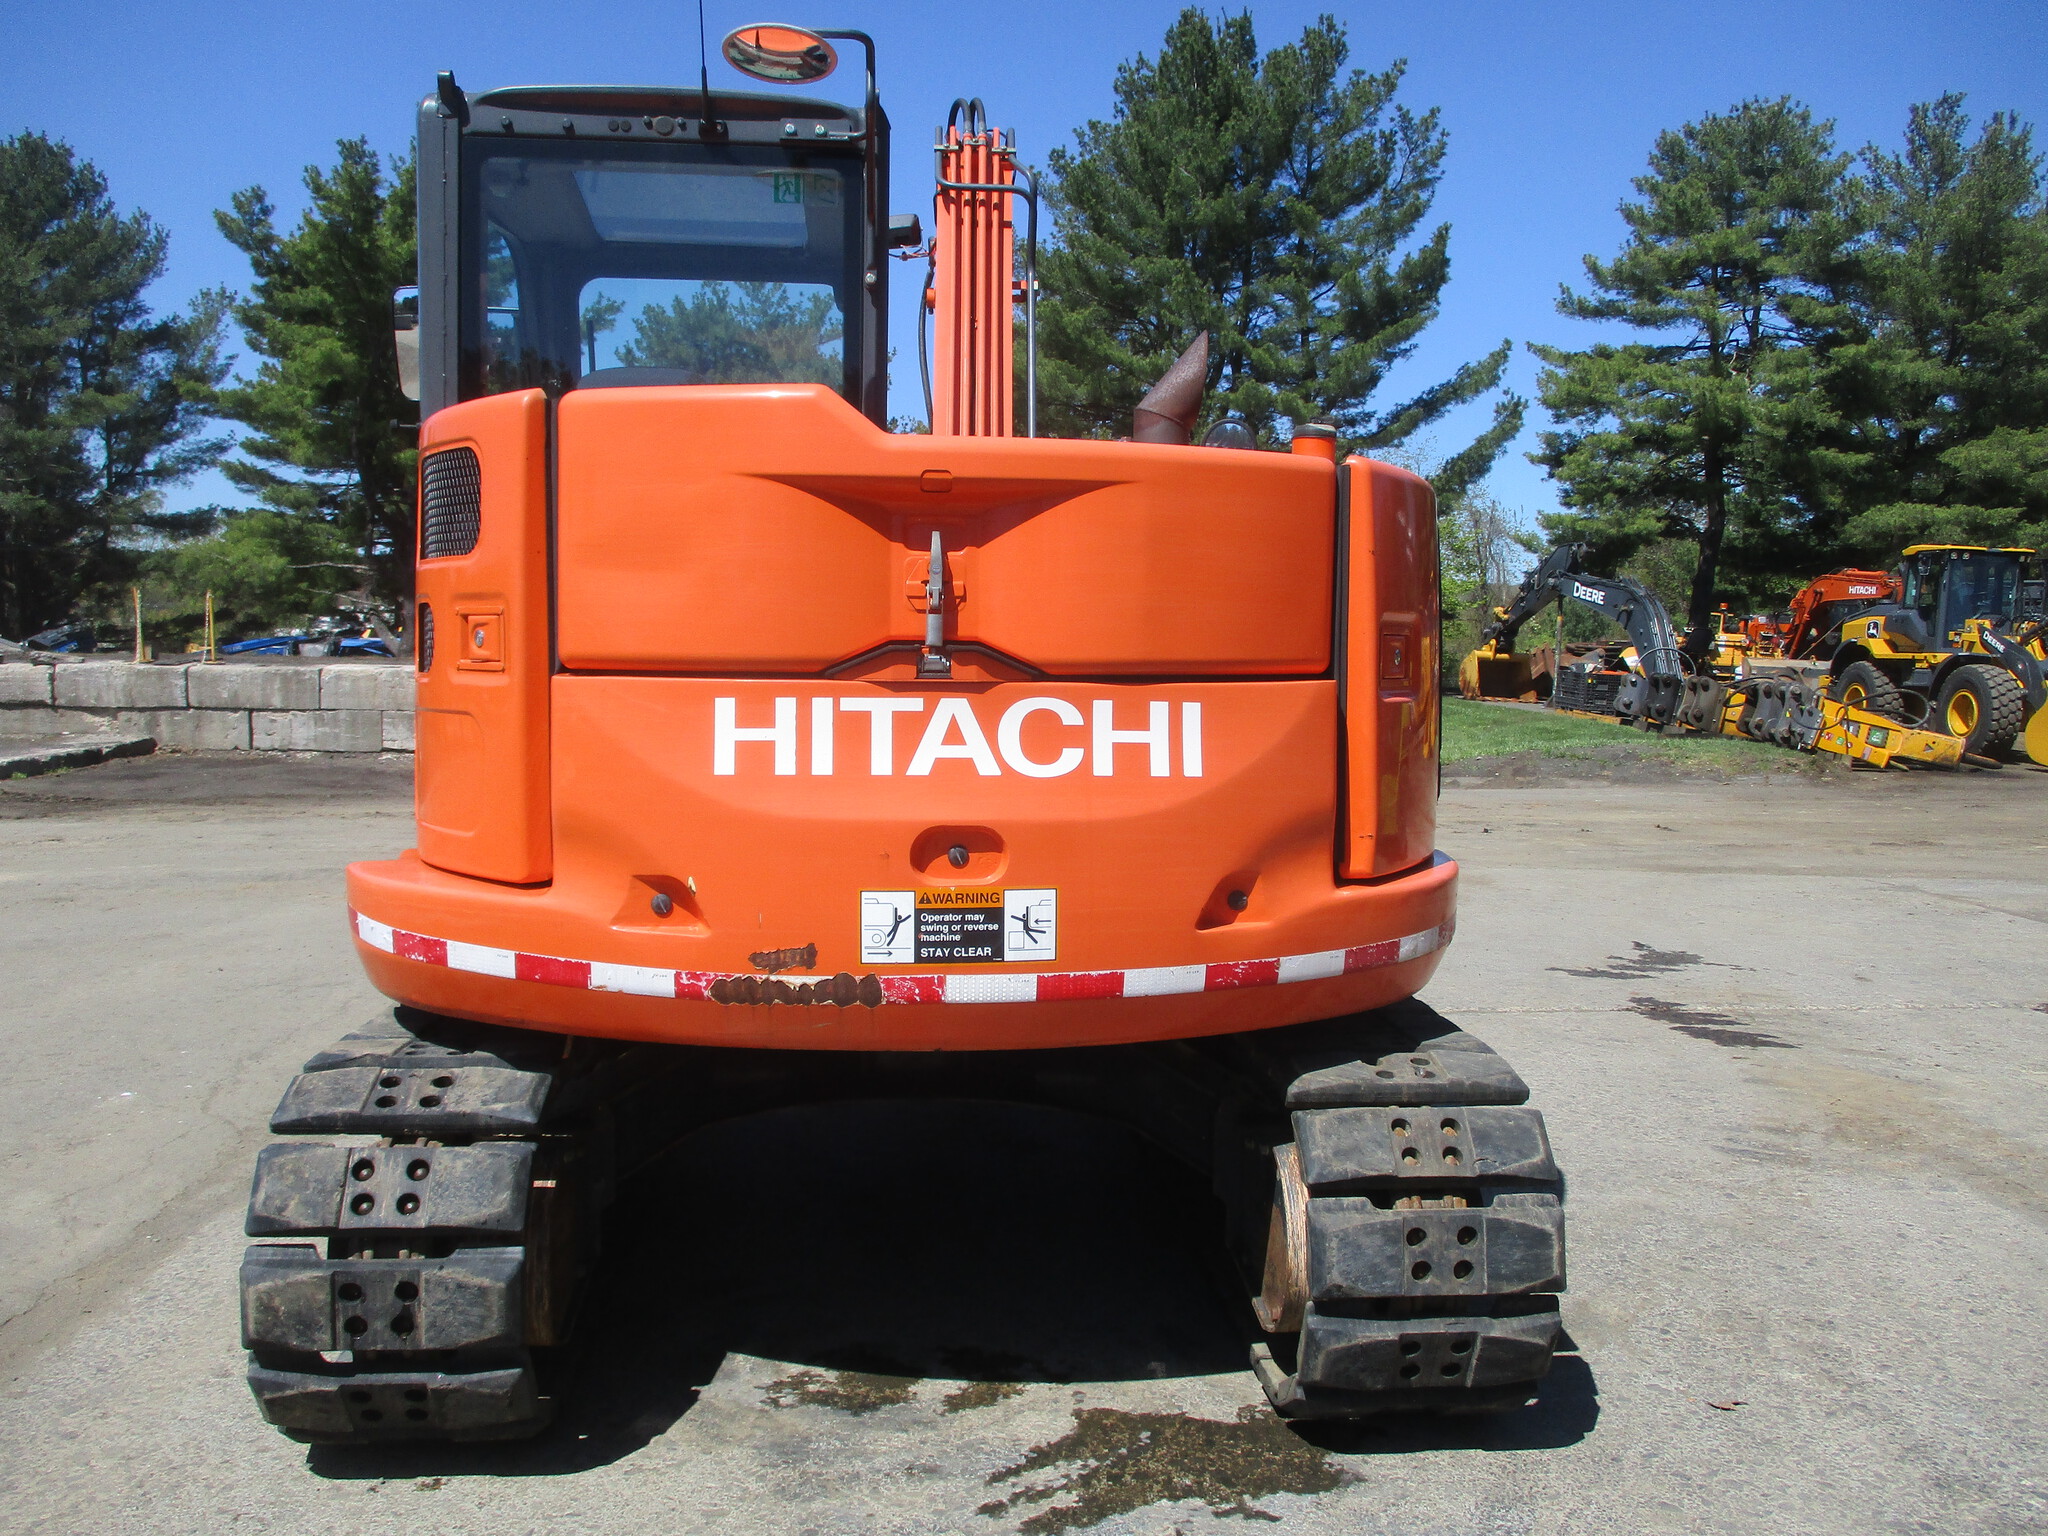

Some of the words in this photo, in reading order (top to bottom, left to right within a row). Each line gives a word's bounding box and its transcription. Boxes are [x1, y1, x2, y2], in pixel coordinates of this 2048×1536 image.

[1573, 581, 1606, 605] DEERE
[1848, 585, 1877, 595] HITACHI
[1982, 630, 2006, 654] DEERE
[713, 696, 1203, 778] HITACHI
[932, 892, 1000, 904] WARNING
[920, 913, 962, 923] Operator
[965, 914, 985, 922] may
[920, 923, 949, 933] swing
[963, 923, 999, 931] reverse
[920, 932, 961, 941] machine
[920, 947, 950, 957] STAY
[953, 947, 992, 957] CLEAR
